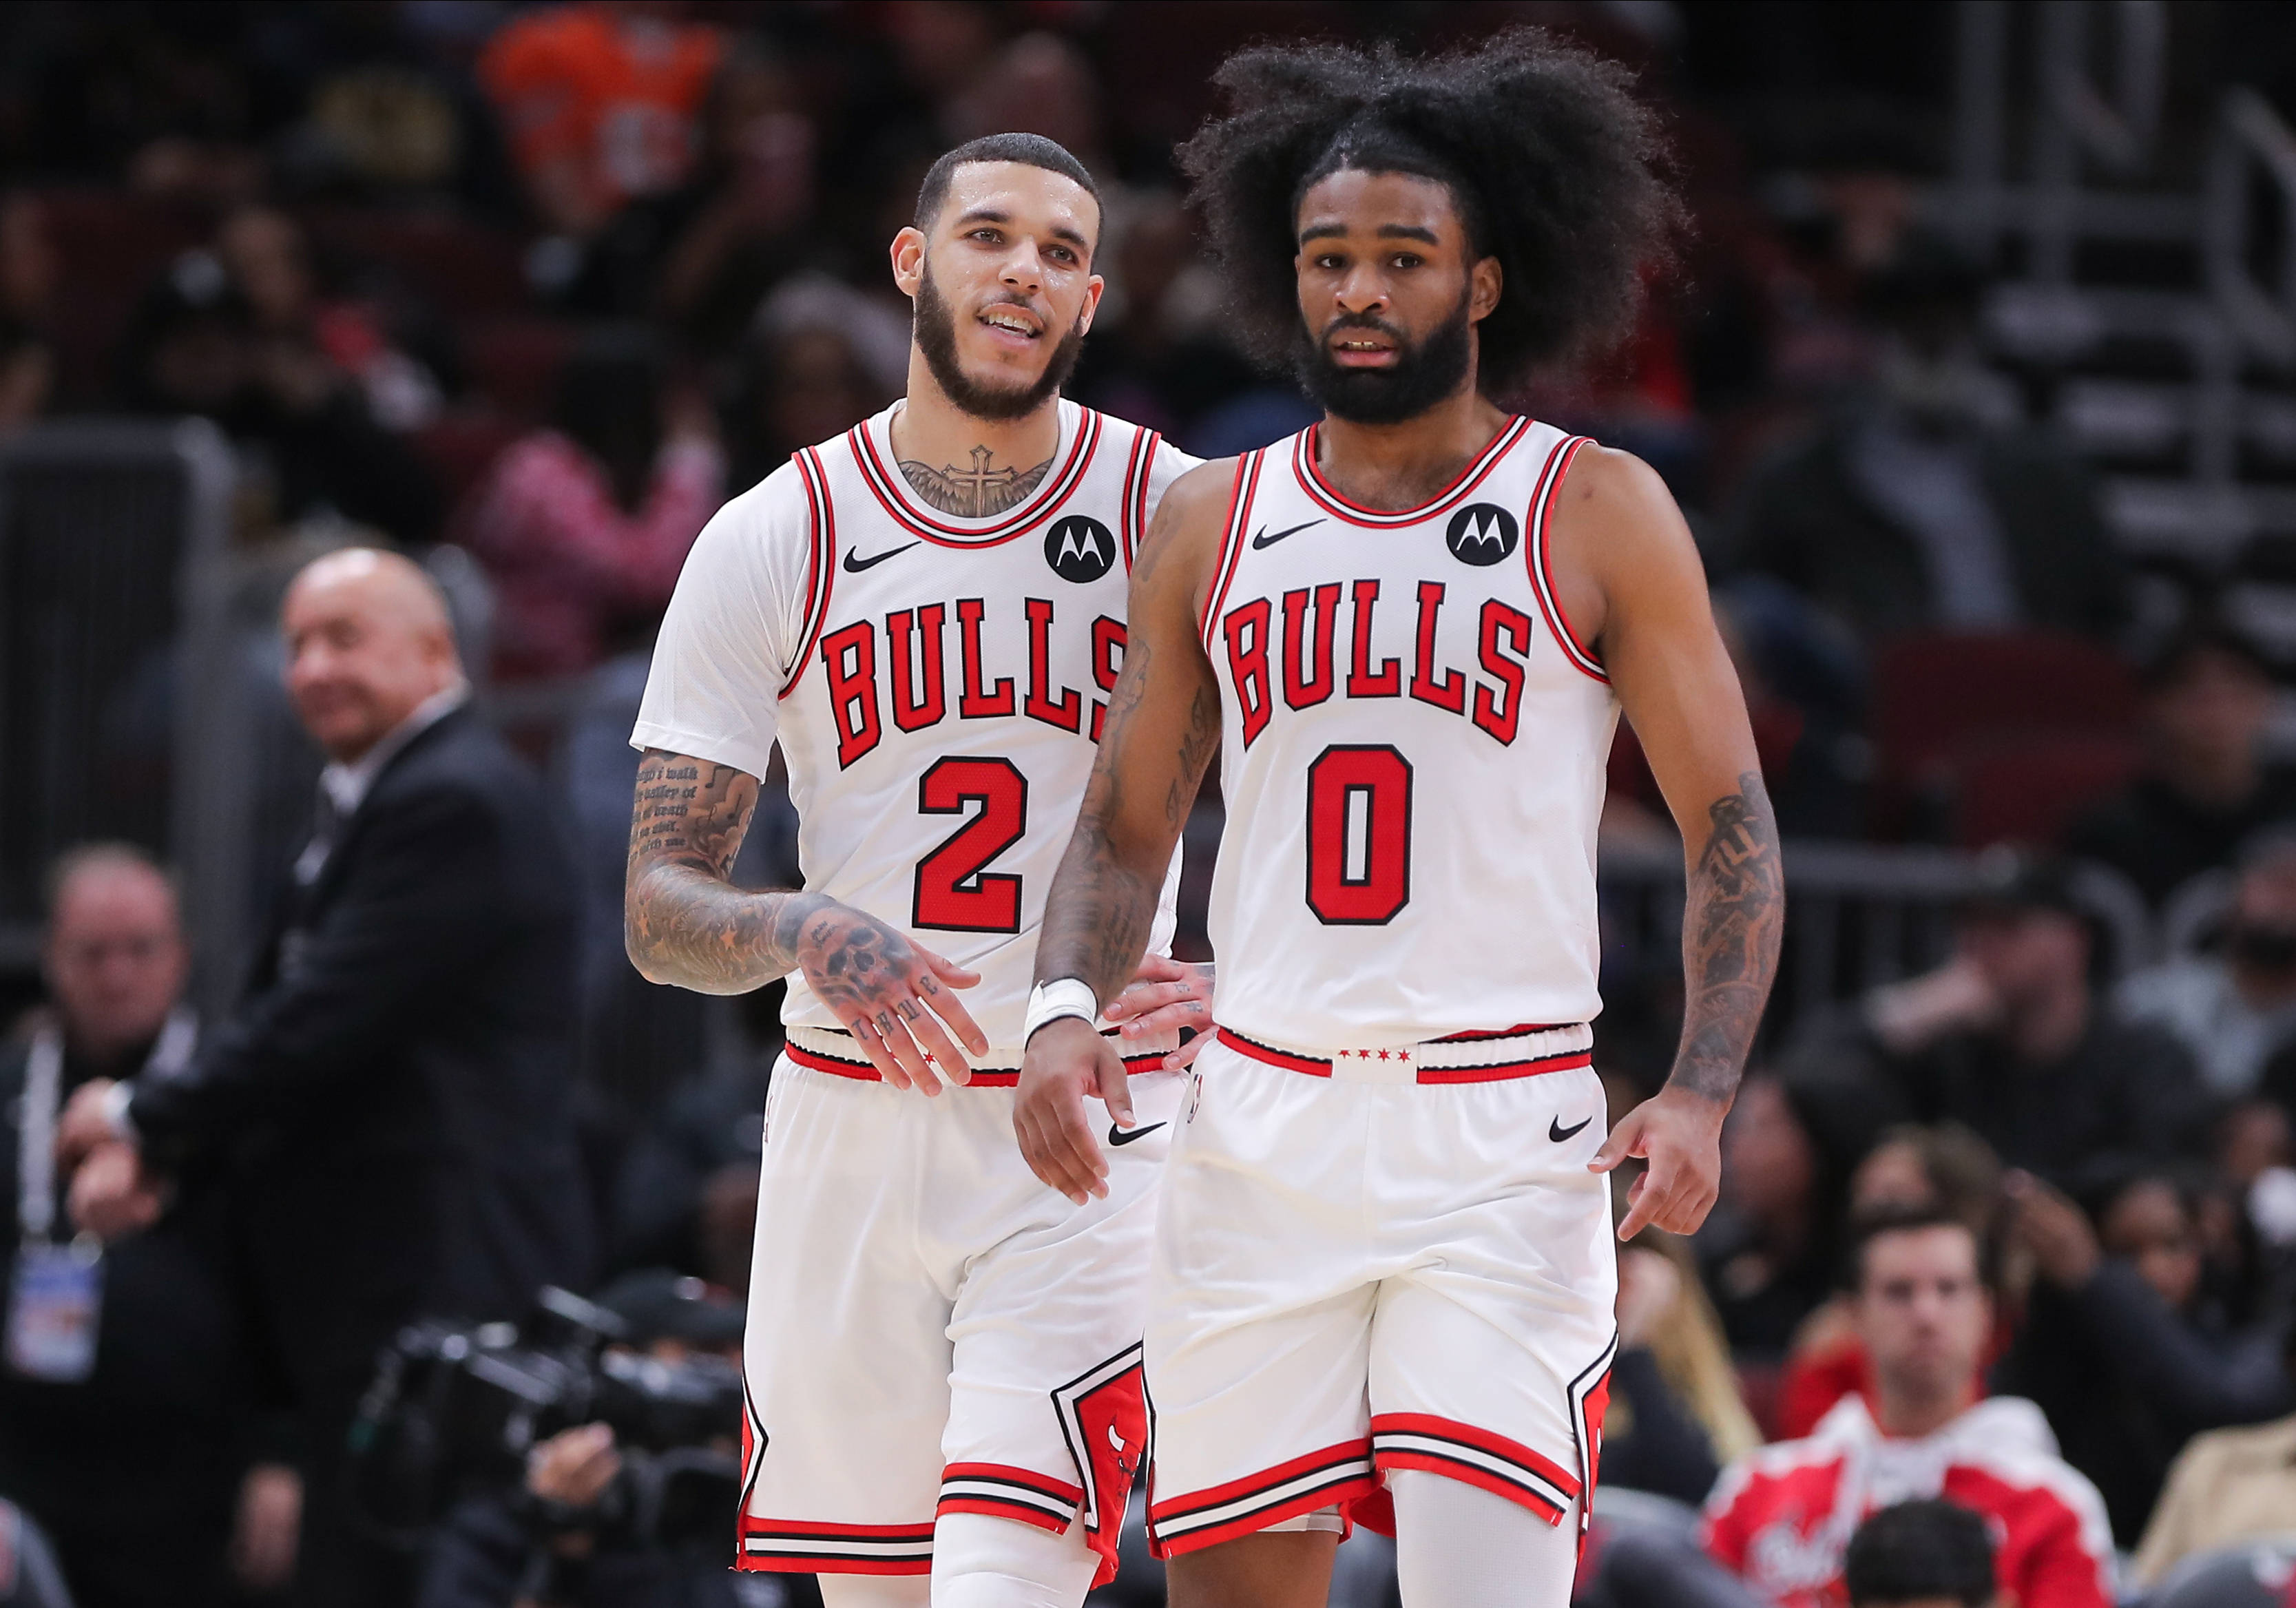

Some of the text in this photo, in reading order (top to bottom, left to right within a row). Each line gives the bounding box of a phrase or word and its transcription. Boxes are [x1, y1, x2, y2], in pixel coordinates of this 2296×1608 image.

[1223, 579, 1532, 751] BULLS
[666, 766, 698, 780] walk
[911, 755, 1028, 934] 2
[1305, 744, 1413, 926] 0
